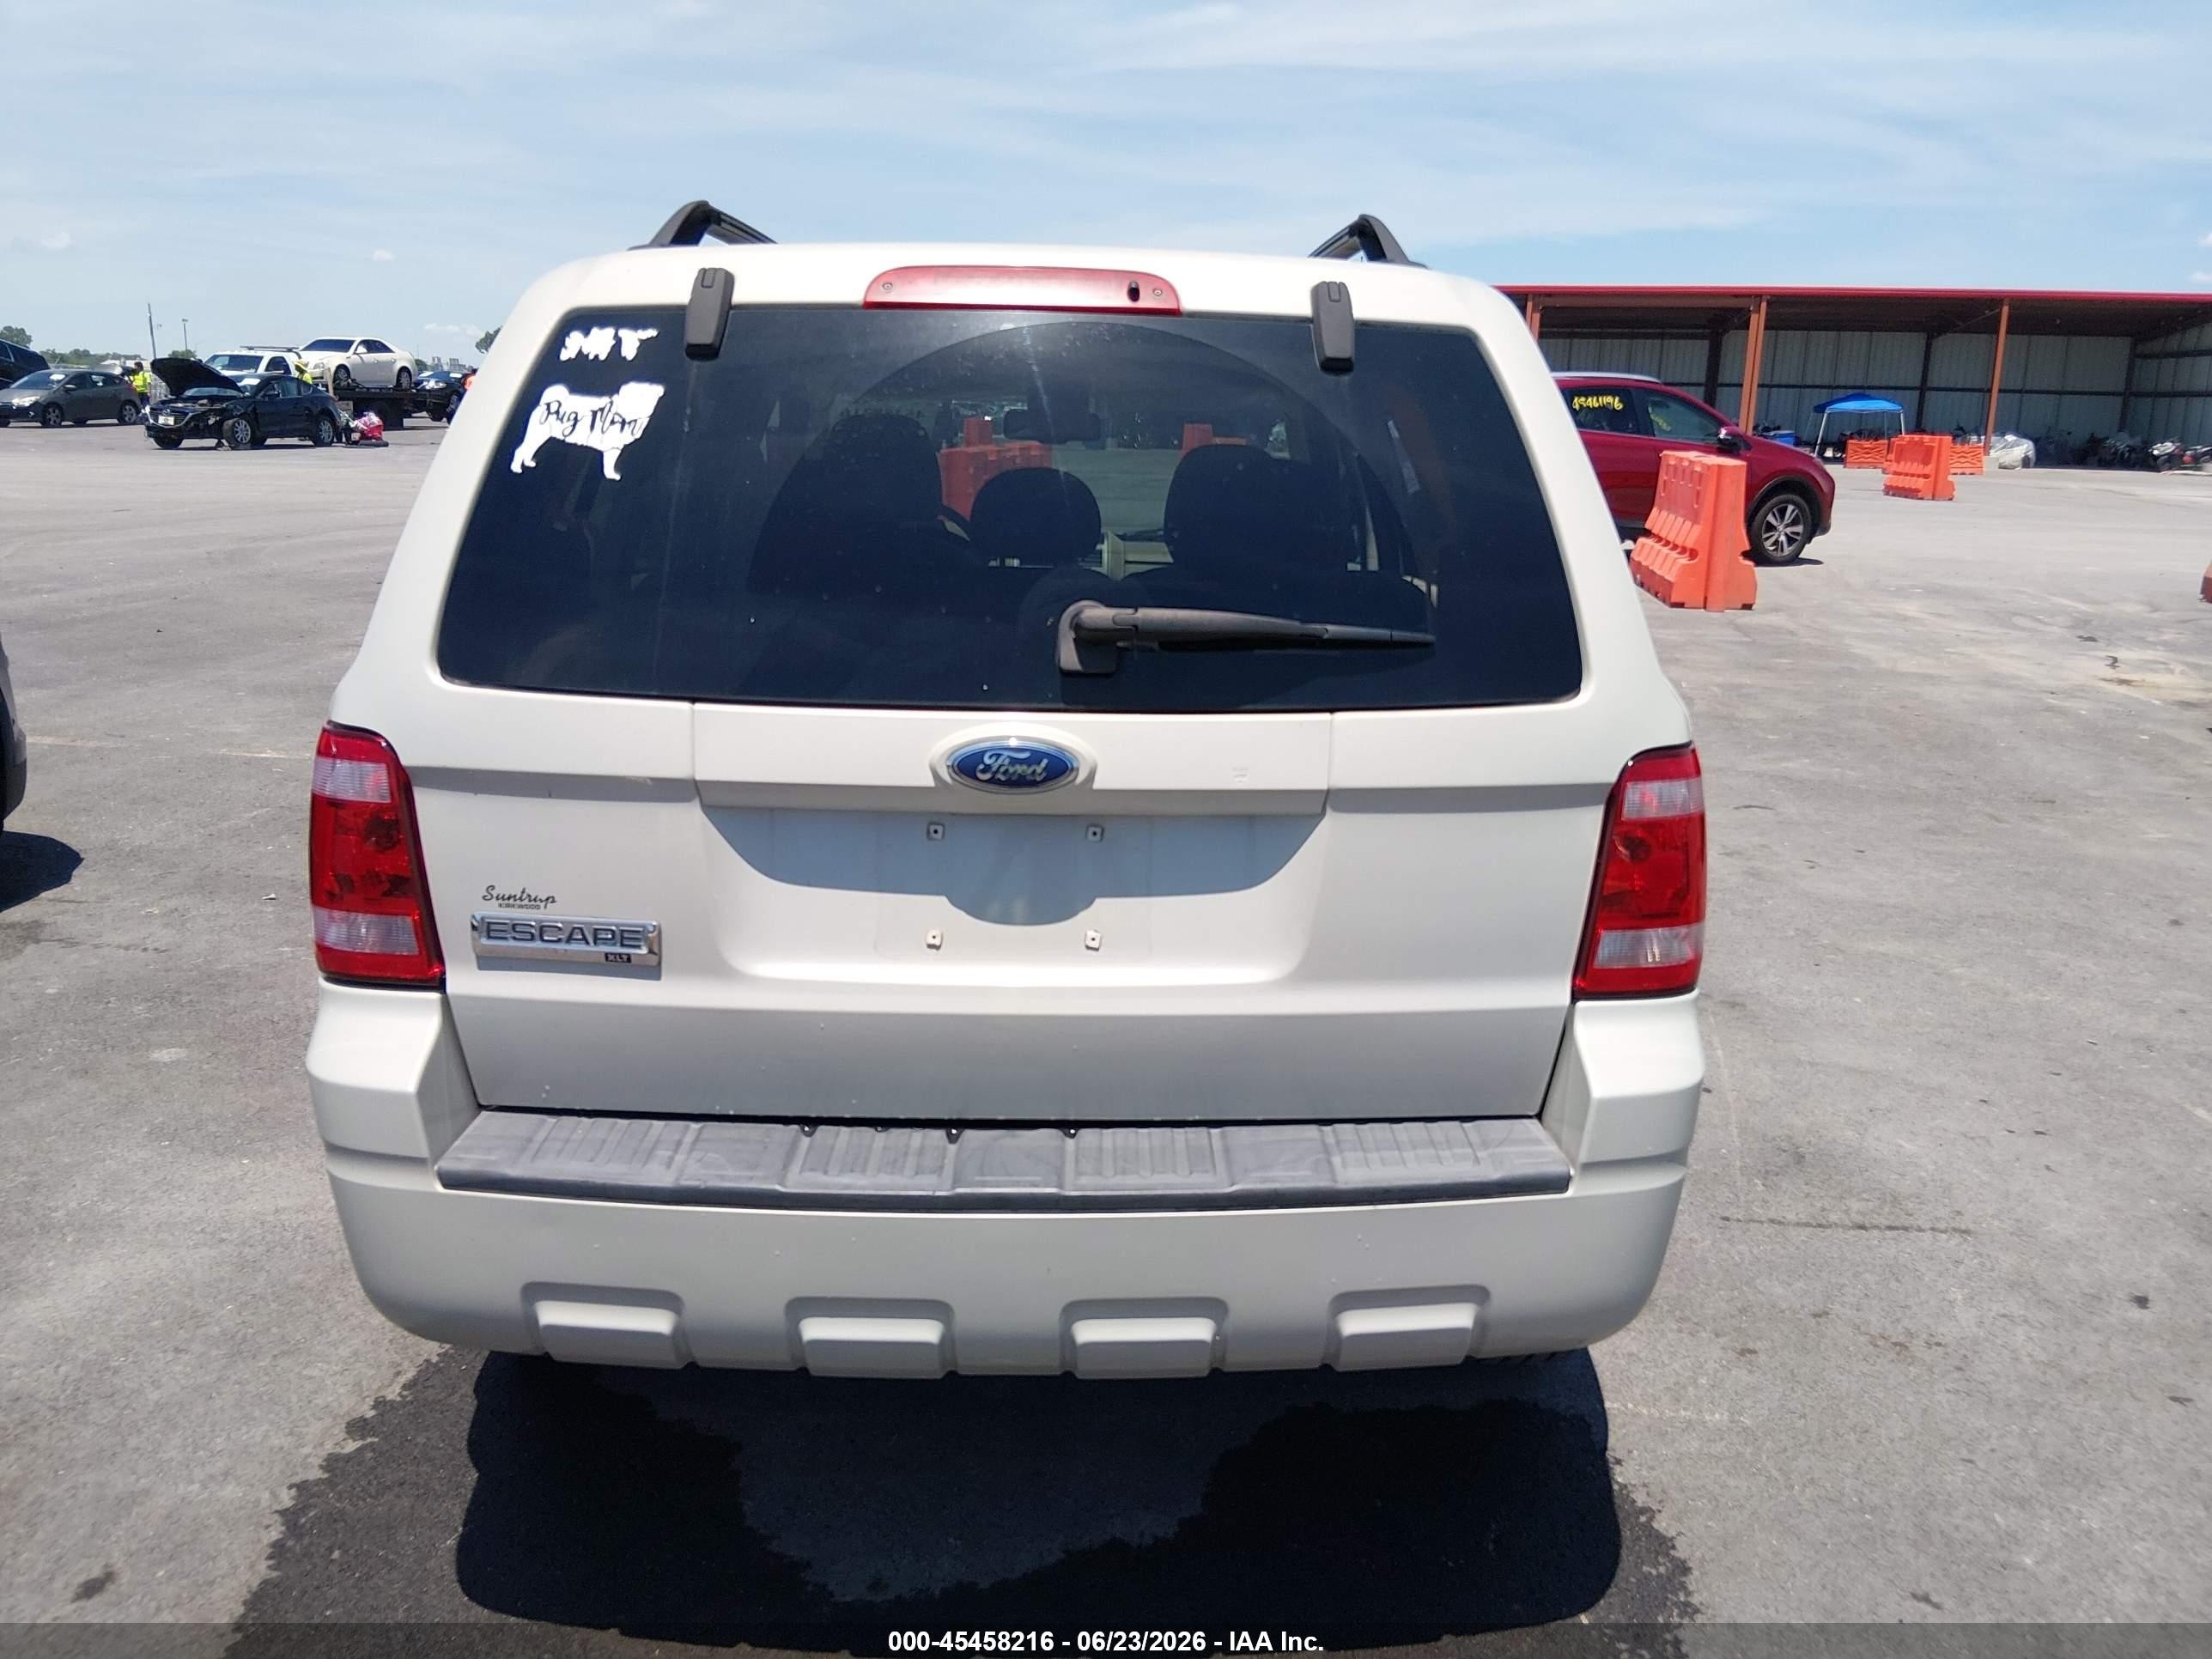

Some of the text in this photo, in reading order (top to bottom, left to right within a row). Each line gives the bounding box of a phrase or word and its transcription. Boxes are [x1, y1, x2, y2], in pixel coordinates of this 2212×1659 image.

[538, 399, 585, 438] Pug
[975, 750, 1048, 781] Ford
[482, 884, 557, 909] Suntrup
[484, 919, 646, 949] ESCAPE
[606, 953, 629, 963] XLT
